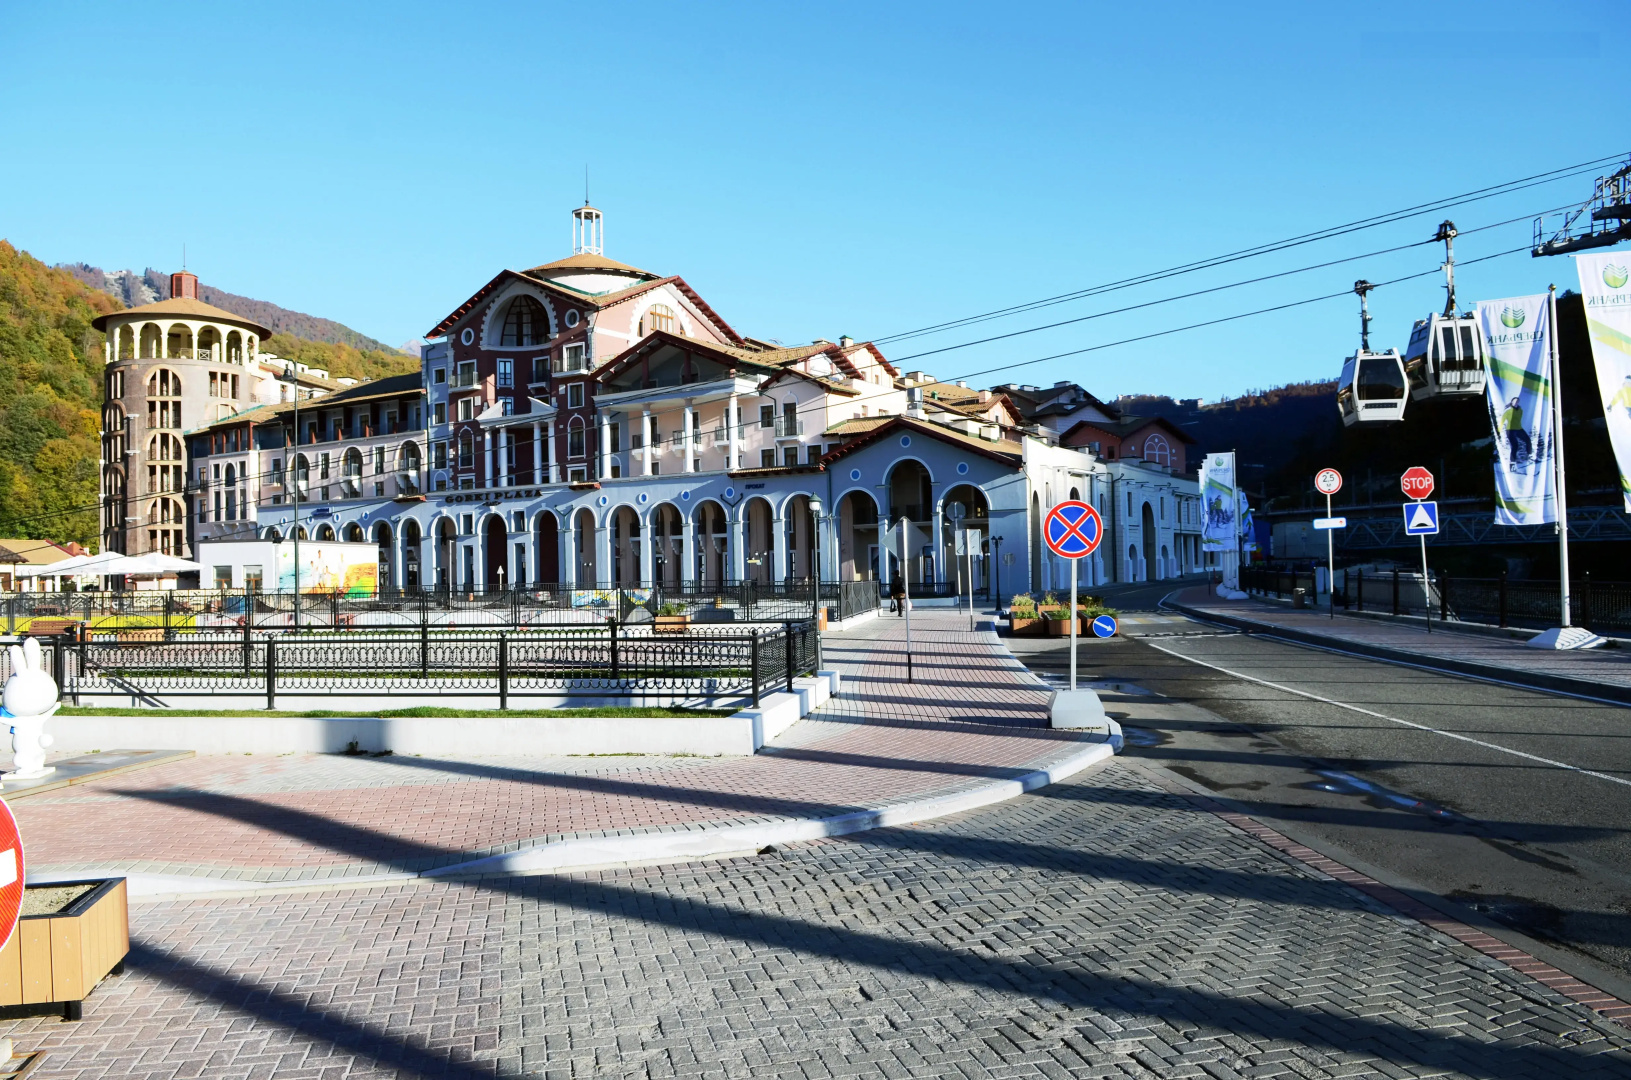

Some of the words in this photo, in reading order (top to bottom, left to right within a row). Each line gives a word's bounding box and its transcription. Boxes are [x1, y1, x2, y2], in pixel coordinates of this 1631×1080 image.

[1403, 477, 1432, 490] STOP
[445, 493, 491, 504] GORKI
[494, 489, 543, 499] PLAZA
